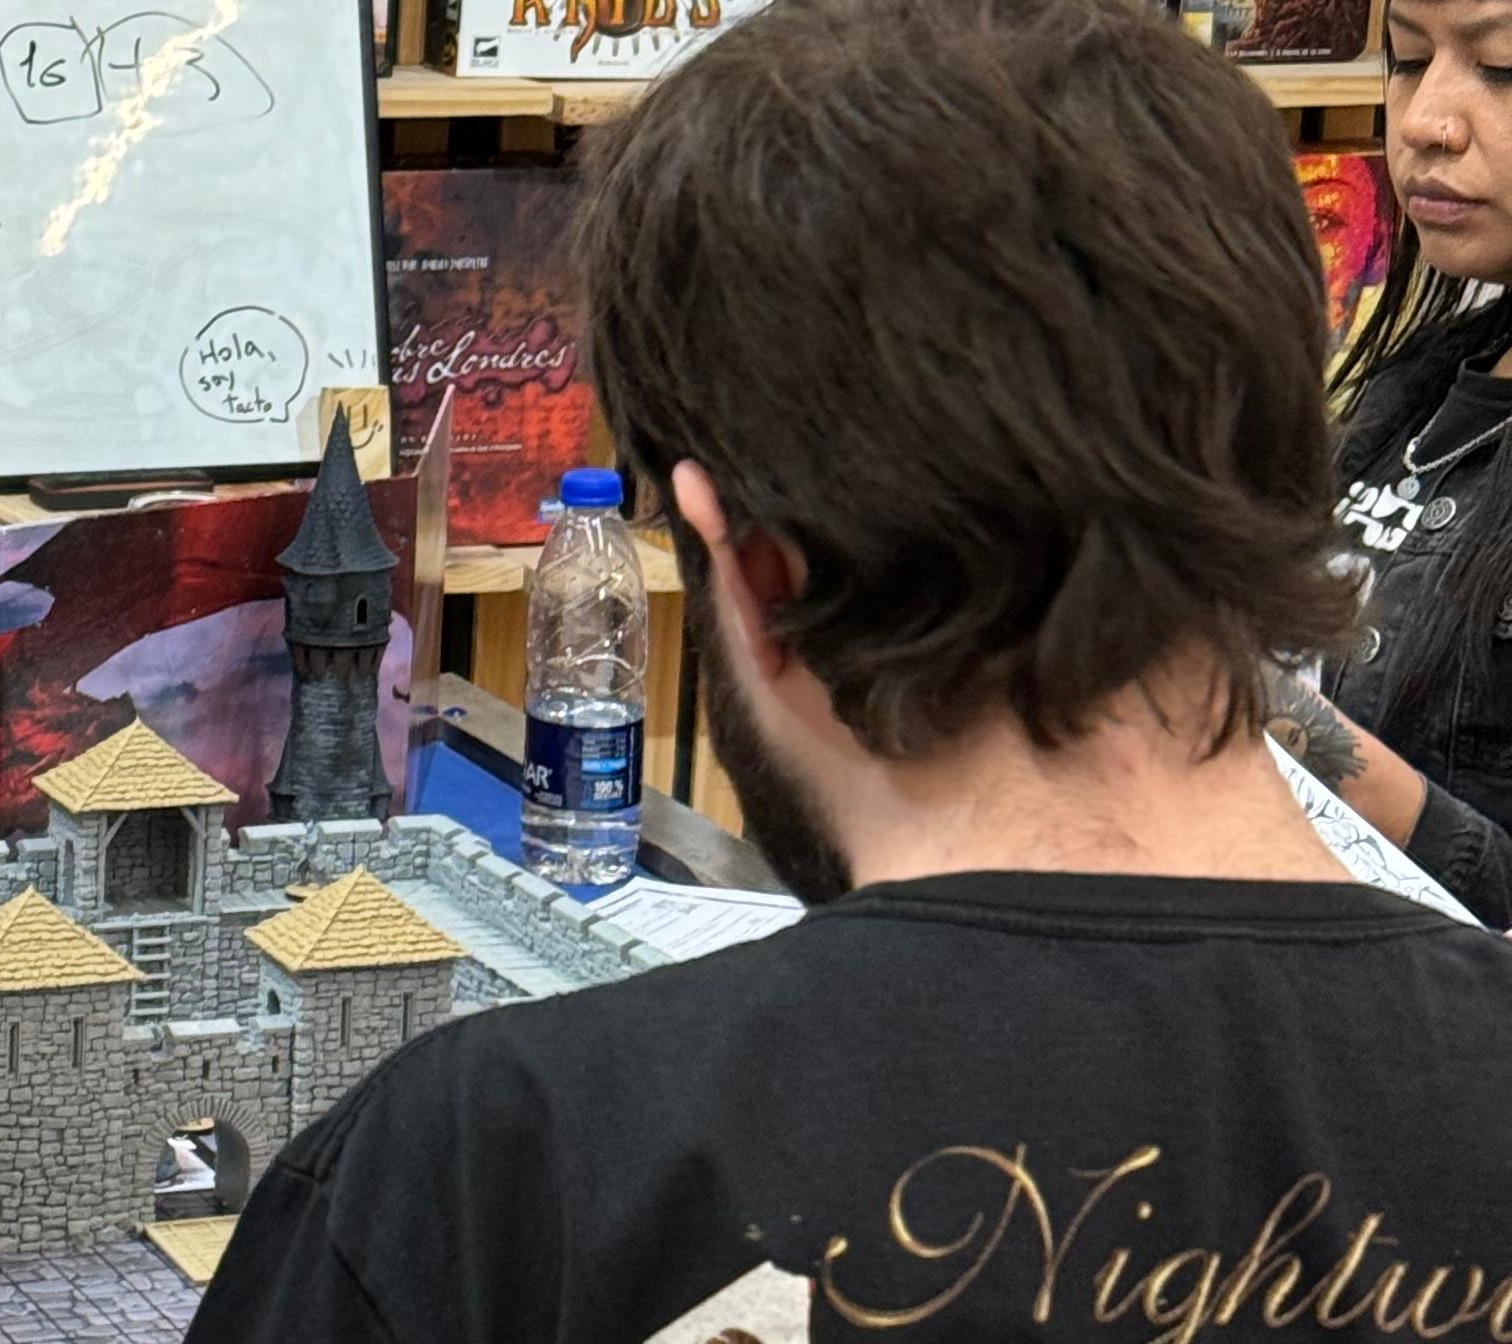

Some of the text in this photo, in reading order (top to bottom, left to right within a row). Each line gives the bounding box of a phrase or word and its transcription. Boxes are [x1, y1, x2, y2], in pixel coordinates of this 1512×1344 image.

[19, 41, 66, 88] 16
[199, 332, 276, 365] Hola,
[425, 329, 569, 385] Londres
[198, 370, 234, 392] soy
